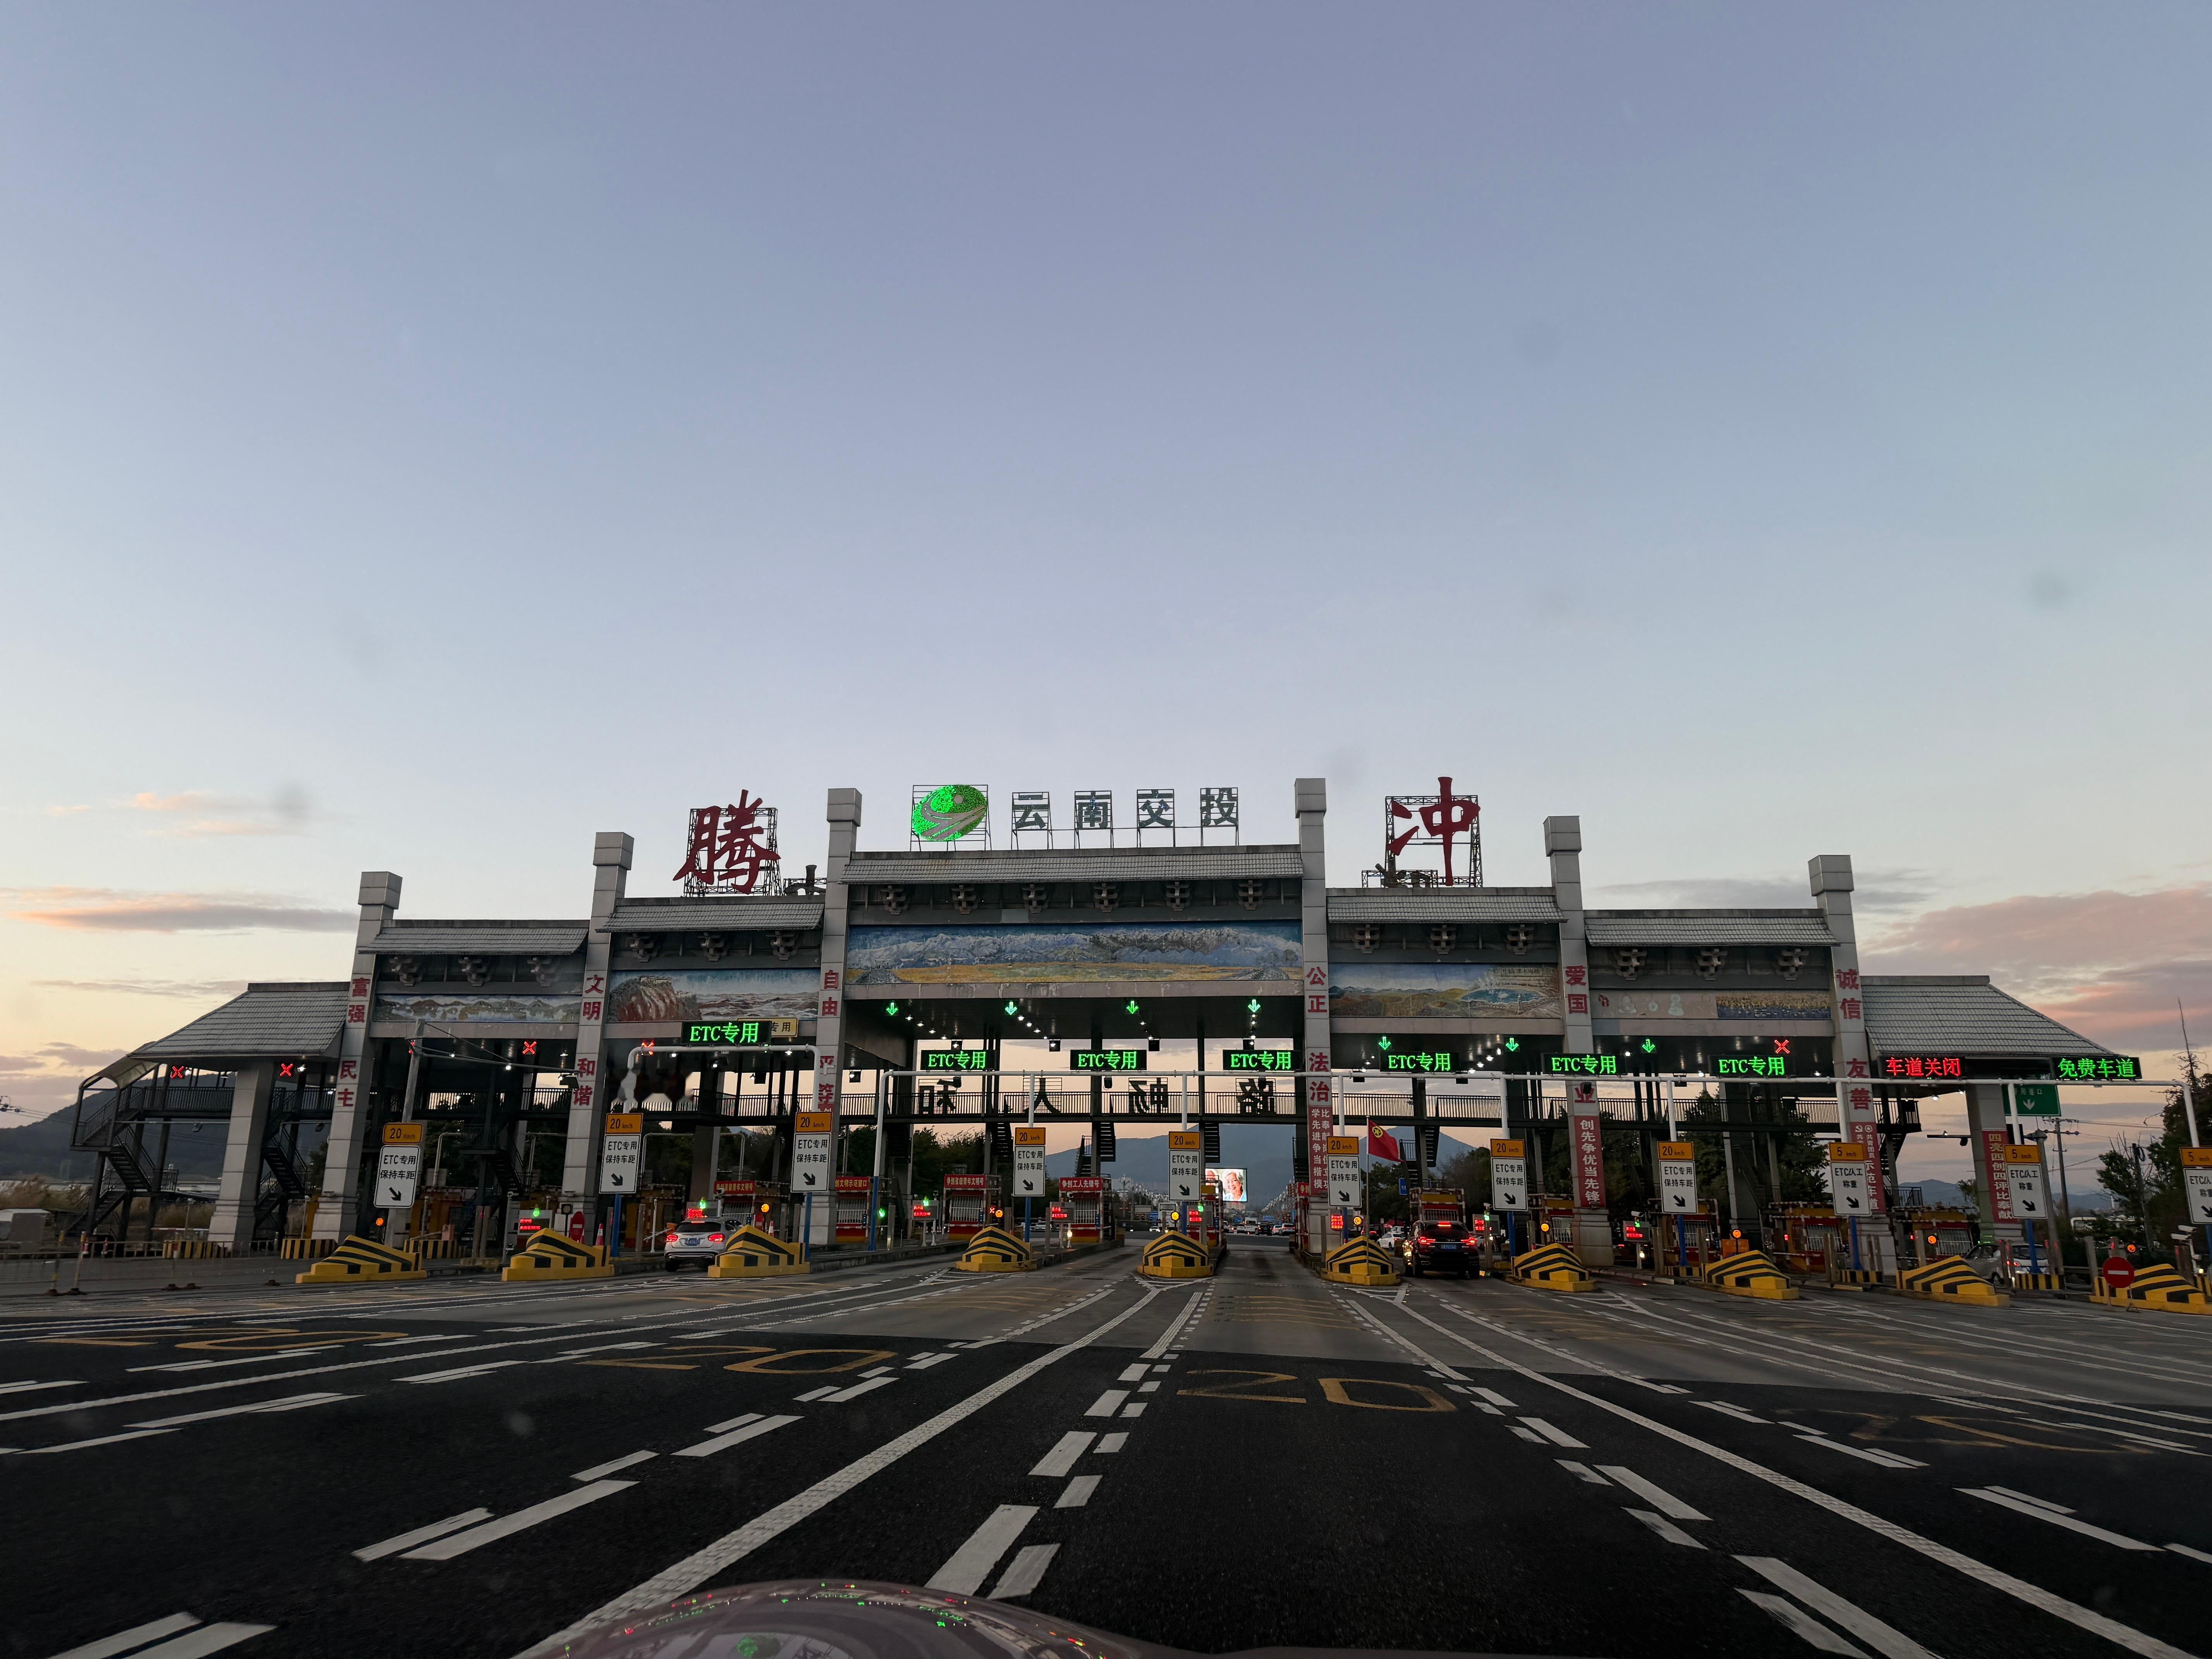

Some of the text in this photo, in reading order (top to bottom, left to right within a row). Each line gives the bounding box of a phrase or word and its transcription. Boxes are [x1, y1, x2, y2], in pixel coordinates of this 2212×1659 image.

[1015, 788, 1237, 830] 云南交投
[1387, 777, 1480, 886] 冲
[673, 789, 781, 895] 腾
[822, 970, 838, 1016] 自由
[1565, 965, 1588, 1013] 爱国
[690, 1022, 759, 1043] ETC专用
[1306, 967, 1329, 1102] 公正 法治
[338, 977, 370, 1107] 富强 民主
[574, 974, 604, 1106] 文明 和谐
[1836, 969, 1871, 1110] 诚信 友善
[928, 1051, 986, 1069] ETC专用
[1078, 1051, 1137, 1069] ETC专用
[1231, 1051, 1291, 1070] ETC专用
[1388, 1053, 1451, 1071] ETC专用
[1552, 1054, 1616, 1074] ETC专用
[1719, 1056, 1784, 1075] ETC专用
[1886, 1057, 1961, 1077] 车道关闭
[2058, 1058, 2137, 1078] 免费车道
[610, 1118, 620, 1129] 20
[800, 1117, 810, 1128] 20
[390, 1128, 402, 1139] 20
[1019, 1132, 1028, 1142] 20
[798, 1139, 828, 1149] ETC专用
[1174, 1135, 1183, 1145] 20
[1331, 1140, 1341, 1150] 20
[608, 1141, 637, 1151] ETC专用
[1312, 1109, 1322, 1188] 学先进争当楷模
[1497, 1143, 1506, 1152] 20
[1663, 1146, 1673, 1156] 20
[1837, 1147, 1842, 1156] 5
[383, 1155, 416, 1164] ETC专用
[606, 1155, 635, 1163] 保持车距
[797, 1154, 827, 1163] 保持车距
[1018, 1151, 1042, 1159] ETC专用
[1172, 1155, 1197, 1163] ETC专用
[2012, 1149, 2018, 1159] 5
[2188, 1152, 2194, 1161] 5
[1331, 1161, 1357, 1169] ETC专用
[1580, 1120, 1600, 1202] 创先争优当先锋
[1172, 1168, 1198, 1176] 保持车距
[1496, 1164, 1523, 1173] ETC专用
[1664, 1166, 1692, 1175] ETC专用
[380, 1170, 415, 1179] 保持车距
[1331, 1173, 1358, 1182] 保持车距
[1988, 1134, 2013, 1219] 四亮四创四评比奉献
[1062, 1180, 1099, 1188] 争创工人先锋号
[1496, 1177, 1524, 1185] 保持车距
[1664, 1179, 1693, 1187] 保持车距
[1176, 1369, 1458, 1412] 20
